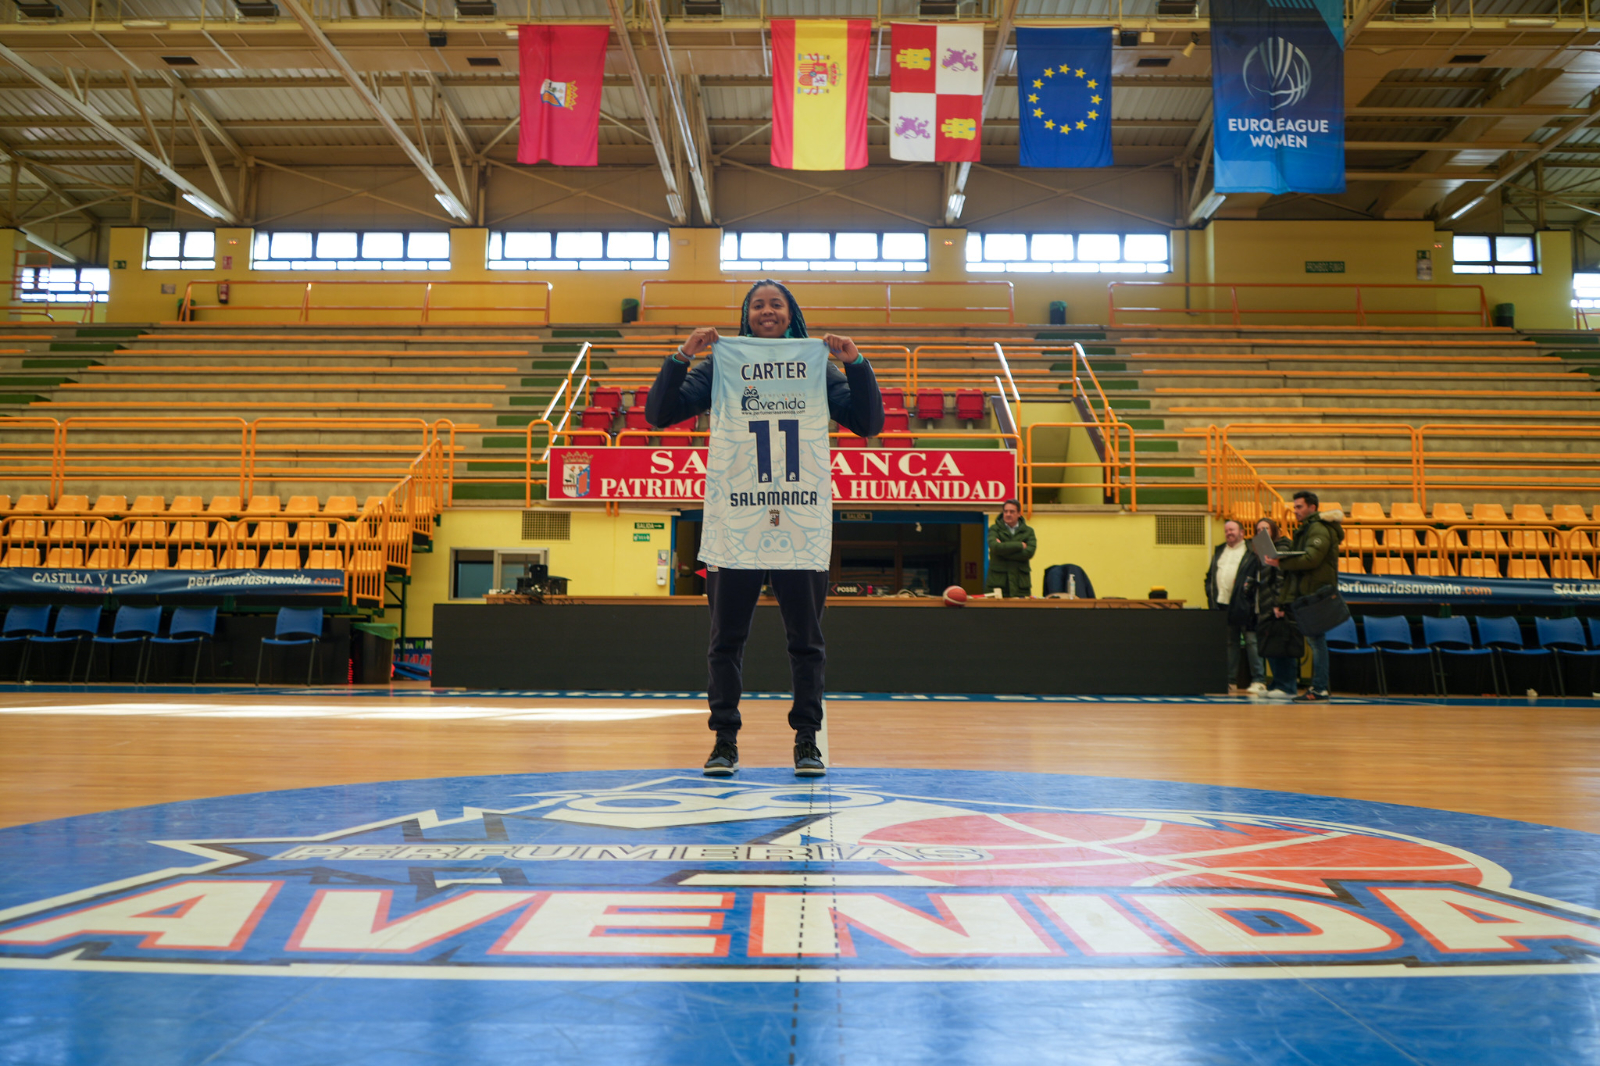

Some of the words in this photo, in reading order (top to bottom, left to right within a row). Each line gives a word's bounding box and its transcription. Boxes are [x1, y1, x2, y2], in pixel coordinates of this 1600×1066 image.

[1228, 118, 1329, 133] EUROLEAGUE
[1249, 134, 1308, 149] WOMEN
[741, 362, 807, 380] CARTER
[748, 419, 800, 483] 11
[849, 480, 1006, 499] HUMANIDAD
[730, 491, 818, 507] SALAMANCA
[32, 572, 93, 584] CASTILLA
[98, 573, 108, 586] Y
[112, 570, 148, 585] LEÓN
[187, 573, 341, 589] perfumeriasavenida.com
[268, 844, 994, 862] PERFUMERIAS
[0, 880, 1600, 958] AVENIDA
